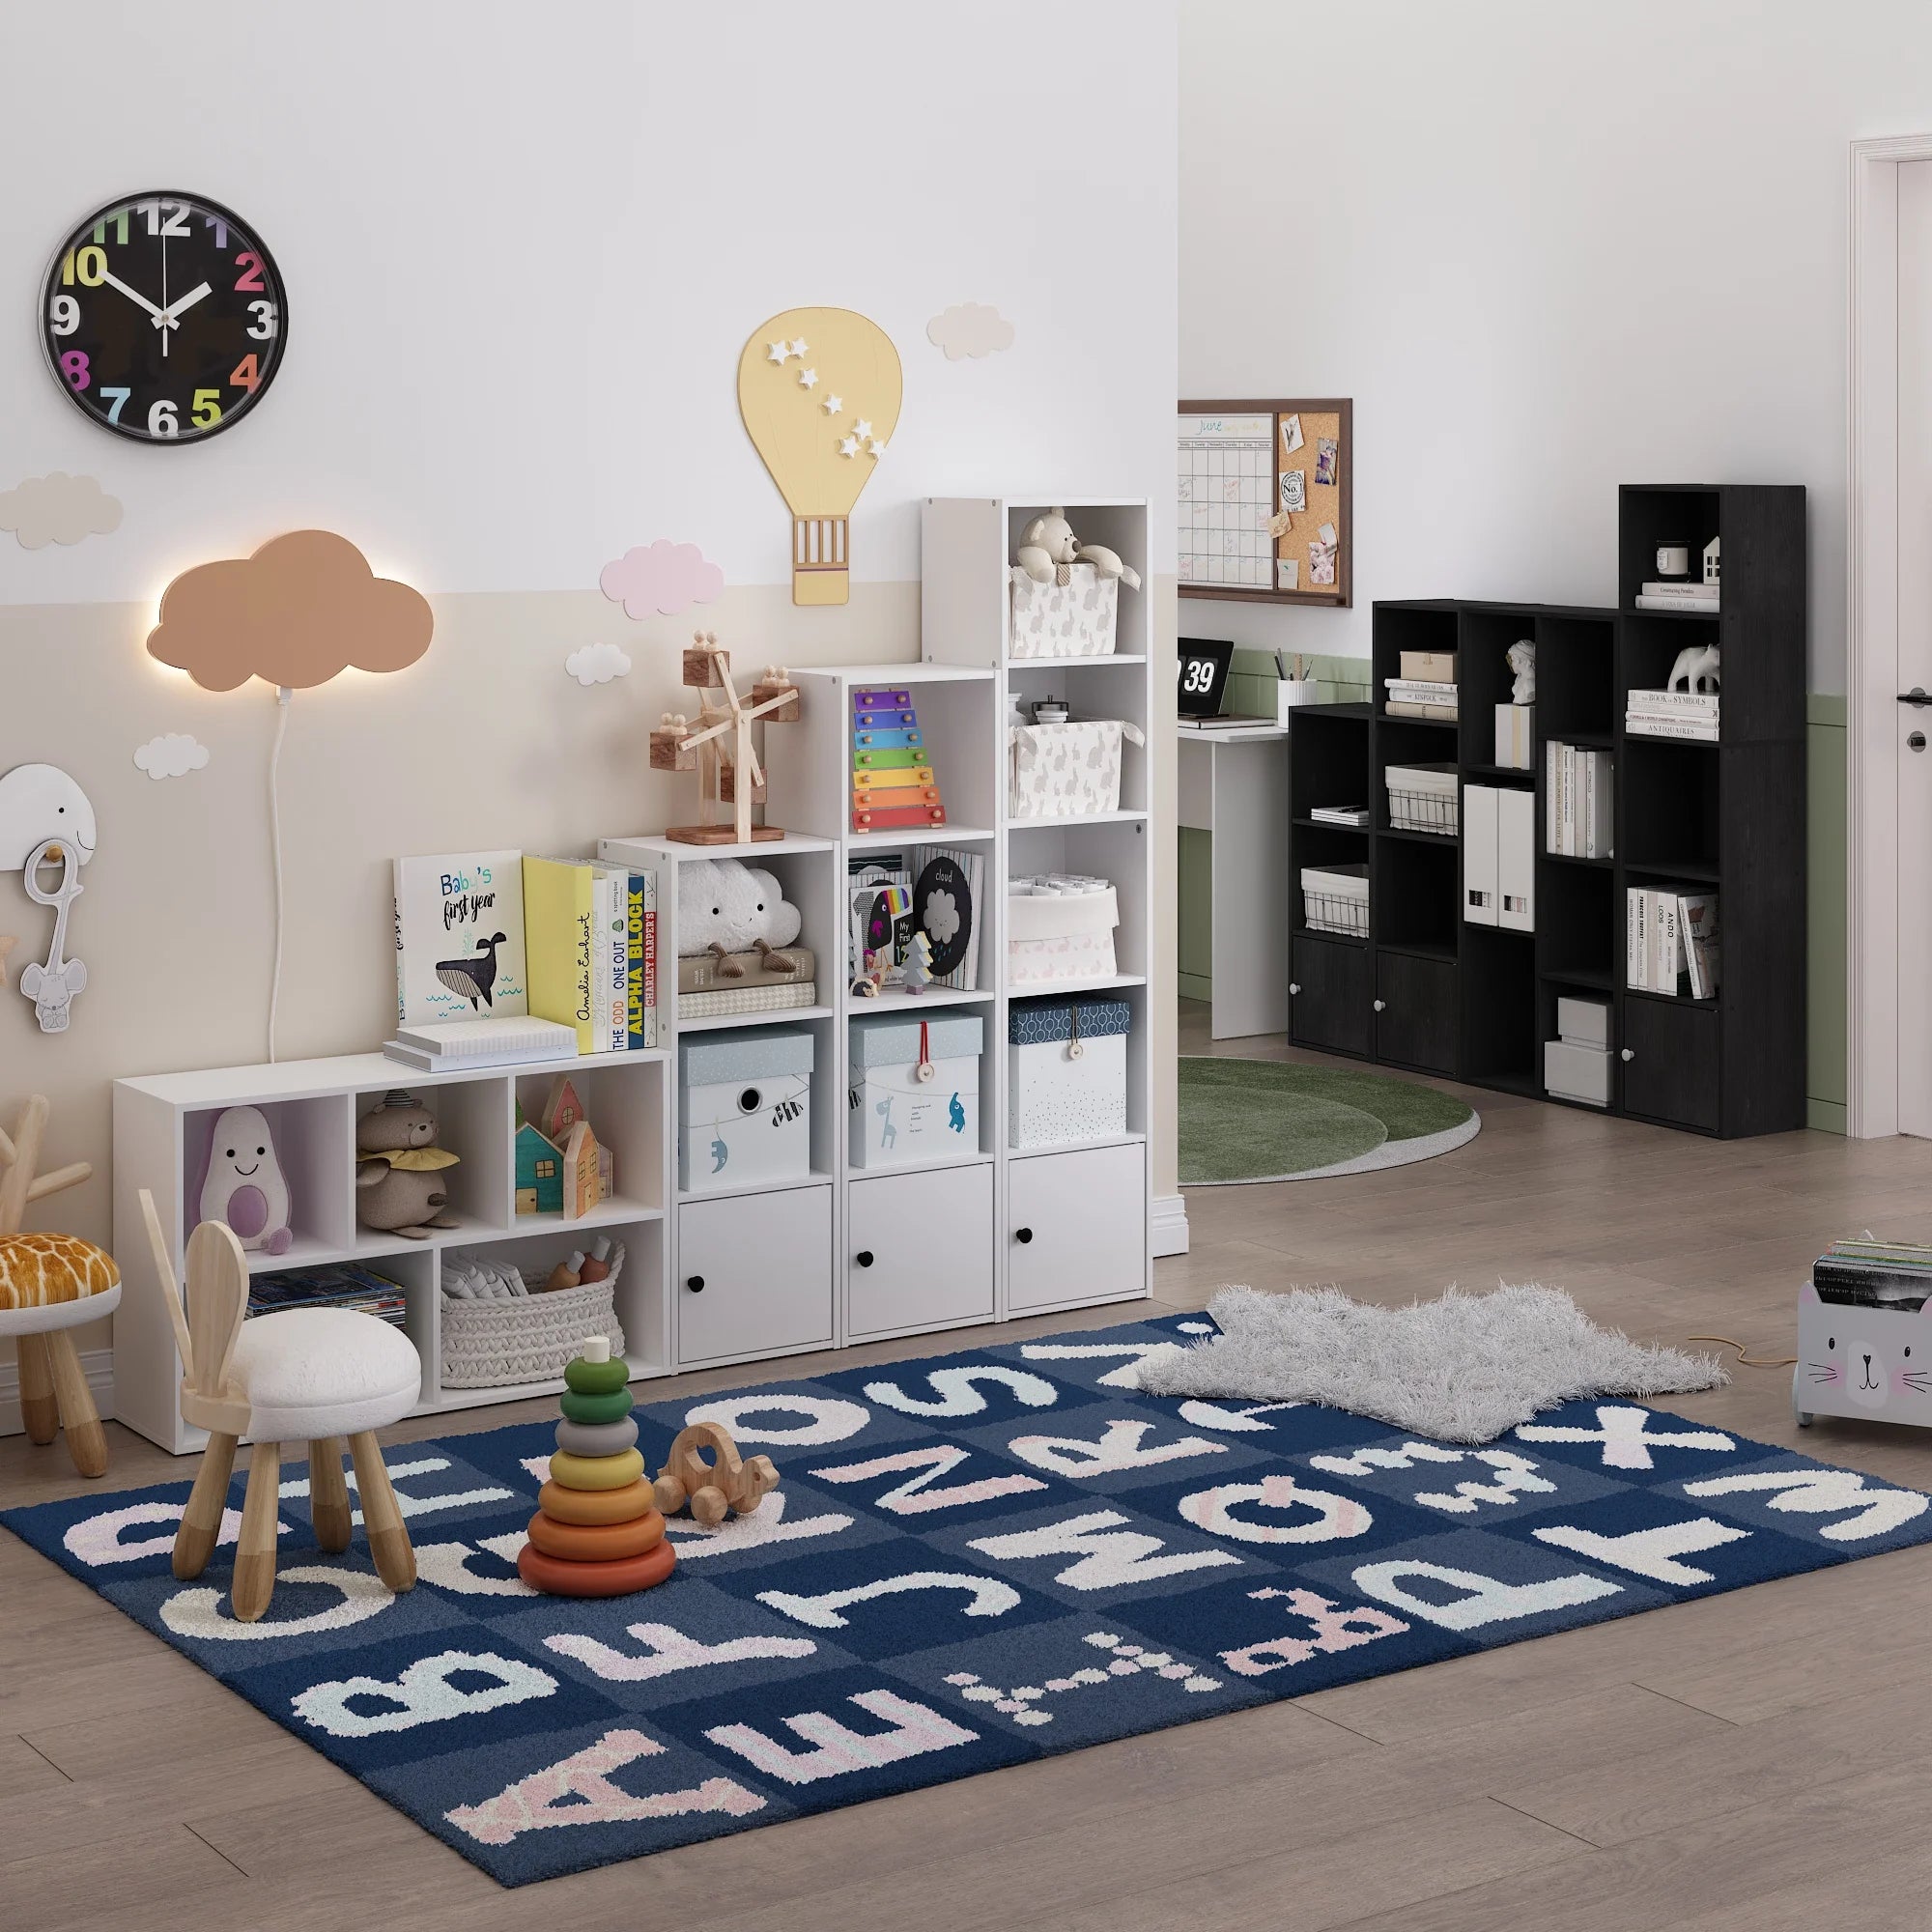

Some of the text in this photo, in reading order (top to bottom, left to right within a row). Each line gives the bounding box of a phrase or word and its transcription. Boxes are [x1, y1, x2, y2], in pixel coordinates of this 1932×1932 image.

[137, 201, 191, 237] 12
[206, 216, 227, 248] 1
[62, 246, 108, 287] 10
[235, 250, 268, 291] 2
[52, 295, 80, 335] 9
[246, 300, 276, 339] 3
[61, 351, 91, 392] 8
[230, 355, 261, 394] 4
[100, 387, 130, 425] 7
[148, 400, 179, 438] 6
[191, 389, 223, 430] 5
[1194, 419, 1222, 436] June
[1184, 661, 1215, 693] 39
[1649, 694, 1668, 703] BOOK
[1673, 696, 1706, 706] SYMBOLS
[440, 867, 492, 896] Baby's
[935, 868, 952, 883] cloud
[443, 892, 496, 930] first year
[899, 922, 910, 933] My
[577, 912, 590, 1021] Amelia Earhart
[612, 941, 625, 964] OUT
[628, 890, 643, 1036] ALPHA BLOCK
[645, 912, 656, 1007] CHARLEY HARPER'S
[612, 967, 625, 990] ONE
[612, 1001, 624, 1025] ODD
[612, 1029, 624, 1050] THE
[863, 1365, 1059, 1417] S
[685, 1393, 870, 1447] O
[1515, 1406, 1737, 1470] X
[1008, 1419, 1230, 1479] R
[808, 1444, 1049, 1516] N
[1178, 1474, 1374, 1545] Q
[1683, 1469, 1931, 1542] W
[965, 1508, 1245, 1591] M
[1531, 1516, 1754, 1587] T
[159, 1565, 396, 1640] C
[755, 1570, 1021, 1629] J
[1351, 1558, 1626, 1632] P
[542, 1622, 818, 1682] F
[291, 1650, 559, 1737] B
[701, 1689, 981, 1786] E
[443, 1729, 769, 1846] A
